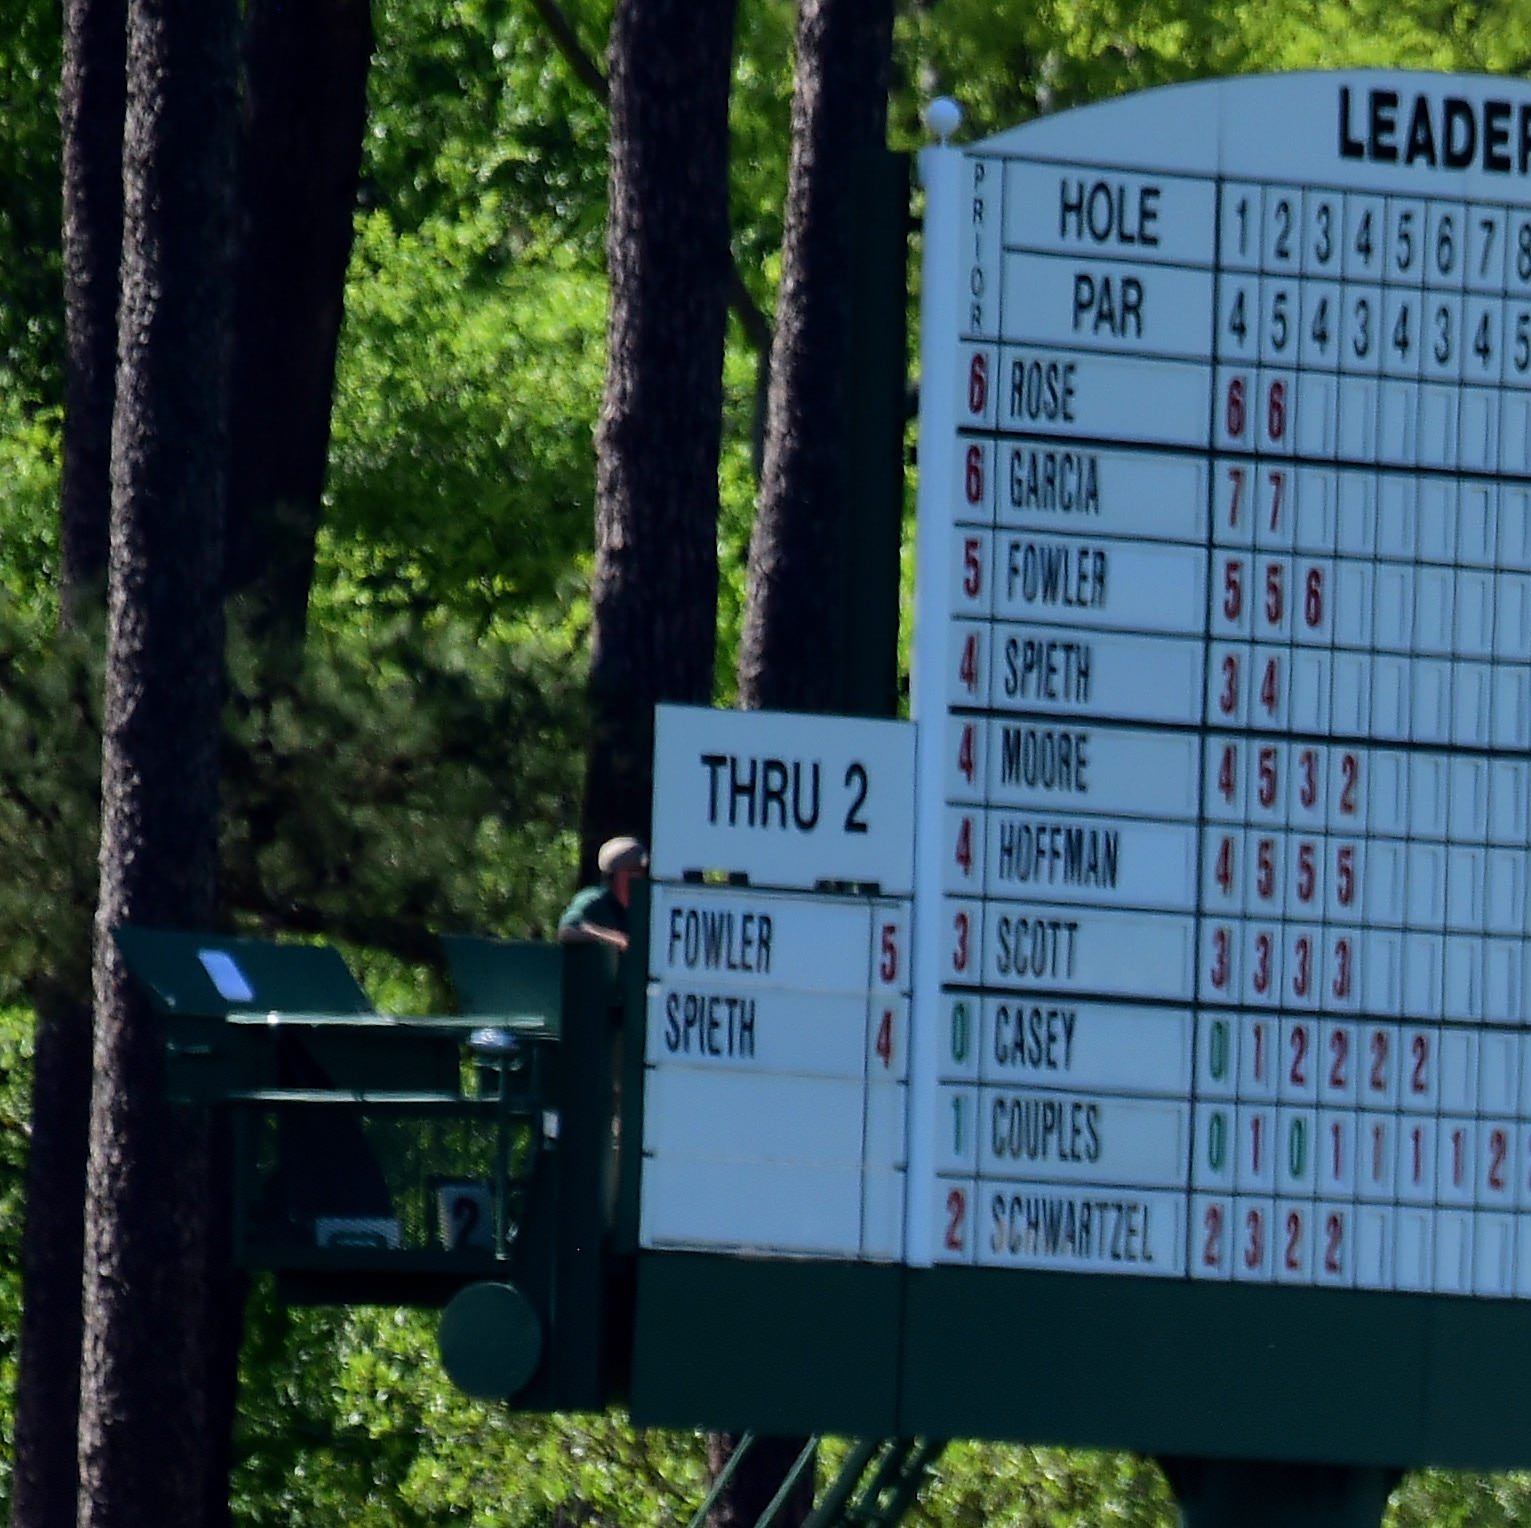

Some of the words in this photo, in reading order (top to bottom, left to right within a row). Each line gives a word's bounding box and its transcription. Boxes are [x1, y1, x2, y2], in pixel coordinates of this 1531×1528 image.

[1059, 180, 1160, 246] HOLE
[1238, 201, 1248, 256] 1
[1275, 202, 1291, 261] 2
[1316, 204, 1330, 264] 3
[1357, 209, 1373, 264] 4
[1397, 214, 1412, 270] 5
[1436, 216, 1451, 273] 6
[1479, 220, 1495, 277] 7
[1073, 275, 1144, 338] PAR
[1228, 291, 1247, 345] 4
[1270, 293, 1288, 351] 5
[1313, 298, 1329, 351] 4
[1354, 300, 1369, 358] 3
[1394, 306, 1409, 360] 4
[1434, 308, 1449, 365] 3
[1474, 313, 1490, 367] 4
[1515, 316, 1530, 372] 5
[969, 354, 988, 414] 6
[1010, 360, 1076, 422] ROSE
[1227, 378, 1245, 438] 6
[1268, 380, 1286, 440] 6
[965, 446, 983, 503] 6
[1009, 452, 1100, 516] GARCIA
[1227, 468, 1245, 528] 7
[1268, 472, 1284, 531] 7
[964, 540, 981, 598] 5
[1008, 542, 1106, 608] FOWLER
[1225, 562, 1242, 622] 5
[1266, 564, 1283, 624] 5
[1306, 568, 1323, 627] 6
[960, 634, 978, 693] 4
[1004, 638, 1091, 702] SPIETH
[1220, 655, 1238, 715] 3
[1260, 658, 1278, 716] 4
[701, 754, 820, 830] THRU
[844, 764, 869, 833] 2
[957, 725, 975, 784] 4
[1001, 728, 1088, 793] MOORE
[1218, 745, 1236, 801] 4
[1259, 749, 1276, 808] 5
[1300, 749, 1317, 808] 3
[1340, 754, 1358, 815] 2
[955, 819, 973, 876] 4
[999, 823, 1119, 889] HOFFMAN
[1216, 837, 1234, 894] 4
[1256, 841, 1274, 898] 5
[1297, 844, 1316, 902] 5
[1335, 848, 1355, 906] 5
[668, 908, 772, 974] FOWLER
[880, 924, 898, 982] 5
[953, 912, 969, 971] 3
[997, 917, 1079, 979] SCOTT
[1212, 929, 1230, 990] 3
[1253, 934, 1270, 994] 3
[1294, 937, 1312, 997] 3
[1334, 939, 1351, 998] 3
[665, 993, 756, 1058] SPIETH
[876, 1010, 894, 1068] 4
[951, 1003, 969, 1063] 0
[995, 1007, 1077, 1071] CASEY
[1210, 1020, 1228, 1081] 0
[1253, 1024, 1264, 1081] 1
[1290, 1026, 1308, 1086] 2
[1329, 1029, 1348, 1089] 2
[1370, 1031, 1388, 1091] 2
[1411, 1035, 1429, 1093] 2
[952, 1096, 963, 1155] 1
[991, 1099, 1100, 1163] COUPLES
[1209, 1112, 1227, 1172] 0
[1252, 1117, 1262, 1175] 1
[1290, 1118, 1306, 1178] 0
[1332, 1124, 1342, 1180] 1
[1372, 1125, 1383, 1181] 1
[1412, 1126, 1423, 1184] 1
[1452, 1129, 1463, 1186] 1
[1489, 1130, 1507, 1191] 2
[945, 1191, 965, 1251] 2
[991, 1196, 1154, 1263] SCHWARTZEL
[1204, 1206, 1223, 1266] 2
[1246, 1210, 1262, 1269] 3
[1285, 1213, 1302, 1269] 2
[1325, 1214, 1342, 1272] 2
